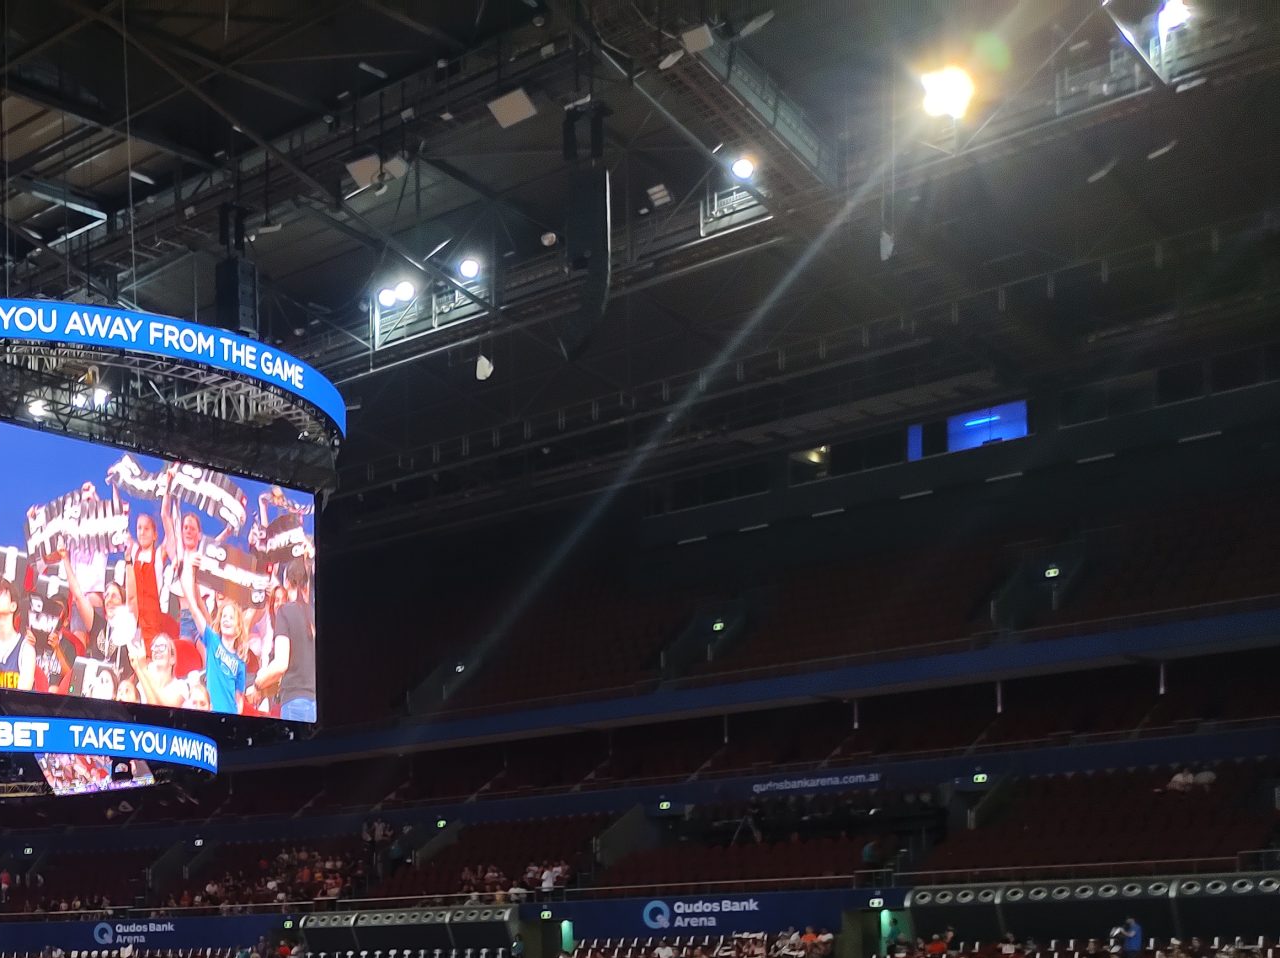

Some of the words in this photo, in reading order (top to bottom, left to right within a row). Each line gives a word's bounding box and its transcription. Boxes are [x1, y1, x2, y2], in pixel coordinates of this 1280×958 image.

[64, 310, 143, 342] AWAY
[149, 322, 214, 358] FROM
[219, 337, 257, 370] THE
[260, 352, 304, 389] GAME
[69, 725, 125, 751] TAKE
[129, 730, 167, 755] YOU
[170, 735, 203, 761] AWAY
[674, 901, 720, 914] Qudos
[722, 899, 759, 911] Bank
[115, 924, 147, 934] Qudos
[149, 922, 175, 932] Bank
[674, 916, 716, 927] Arena
[115, 934, 145, 944] Arena
